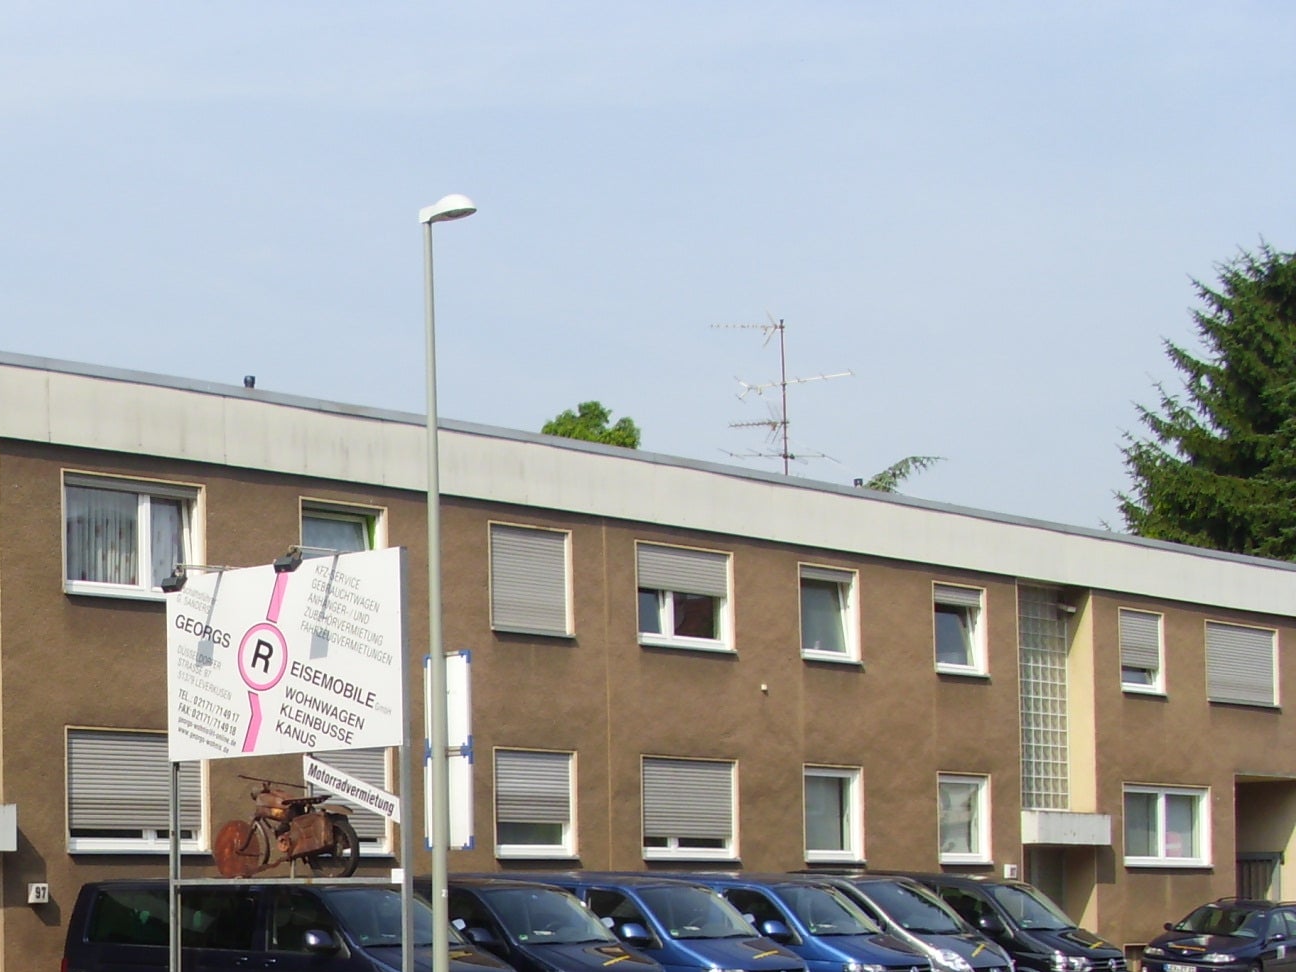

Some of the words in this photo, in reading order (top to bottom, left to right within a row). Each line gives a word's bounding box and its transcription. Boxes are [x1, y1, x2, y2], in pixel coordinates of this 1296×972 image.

[311, 578, 381, 613] GEBRAUCHTWAGEN
[175, 614, 231, 648] GEORGS
[300, 620, 393, 666] FAHRZEUGVERMIETUNGEN
[251, 638, 274, 673] R
[290, 661, 376, 708] EISEMOBILE
[279, 703, 354, 744] KLEINBUSSE
[285, 686, 365, 730] WOHNWAGEN
[275, 720, 317, 747] KANUS
[308, 763, 395, 816] Motorradvermietung
[35, 886, 47, 899] 97
